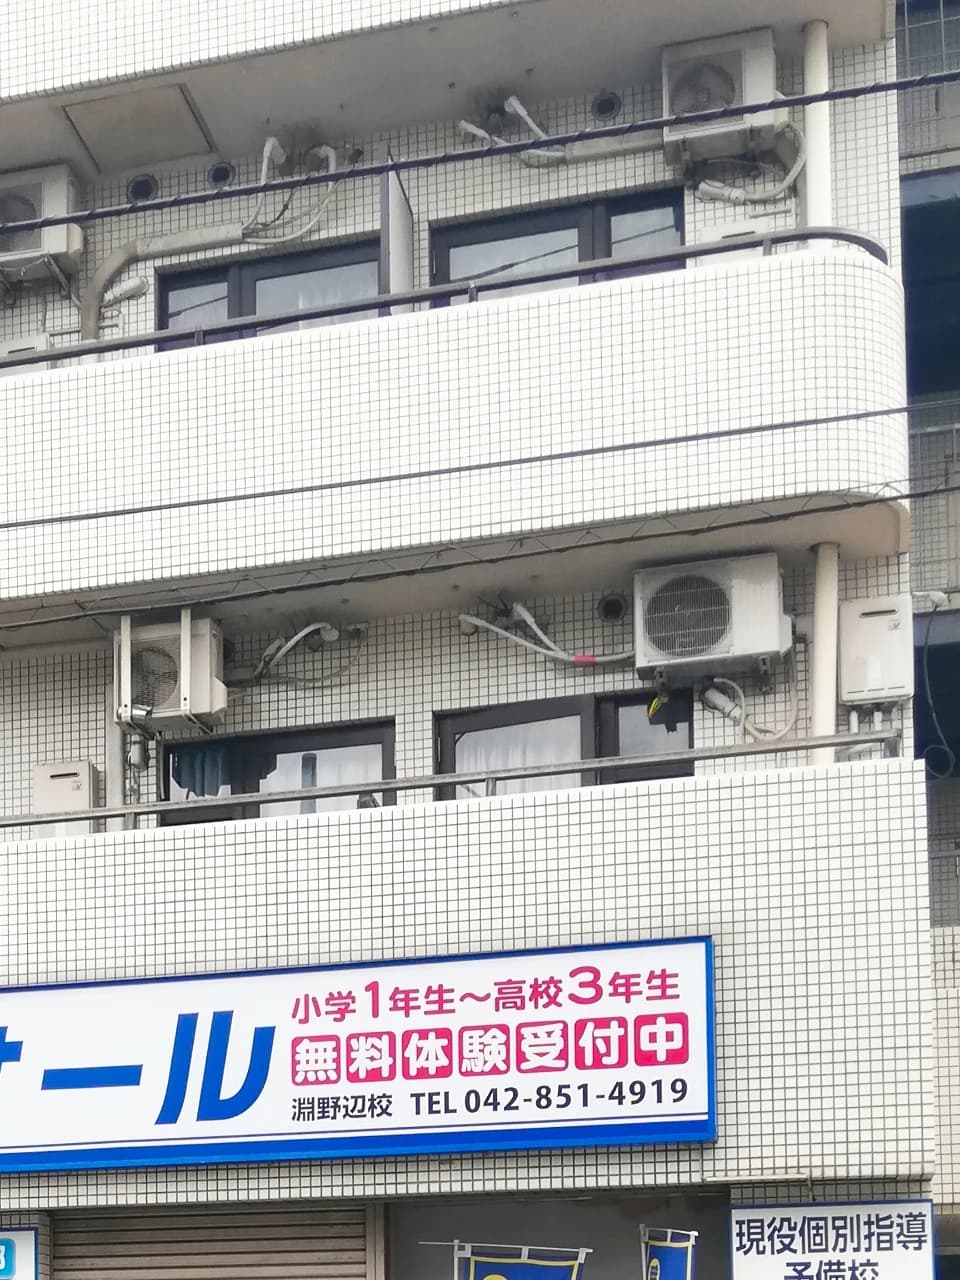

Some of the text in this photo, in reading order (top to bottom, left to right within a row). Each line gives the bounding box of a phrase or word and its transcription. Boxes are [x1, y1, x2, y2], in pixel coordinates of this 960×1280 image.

[291, 1012, 689, 1087] 無料体験受付中
[291, 1078, 689, 1121] 淵野辺校 TEL 042-851-4919
[735, 1211, 928, 1256] 現役個別指導
